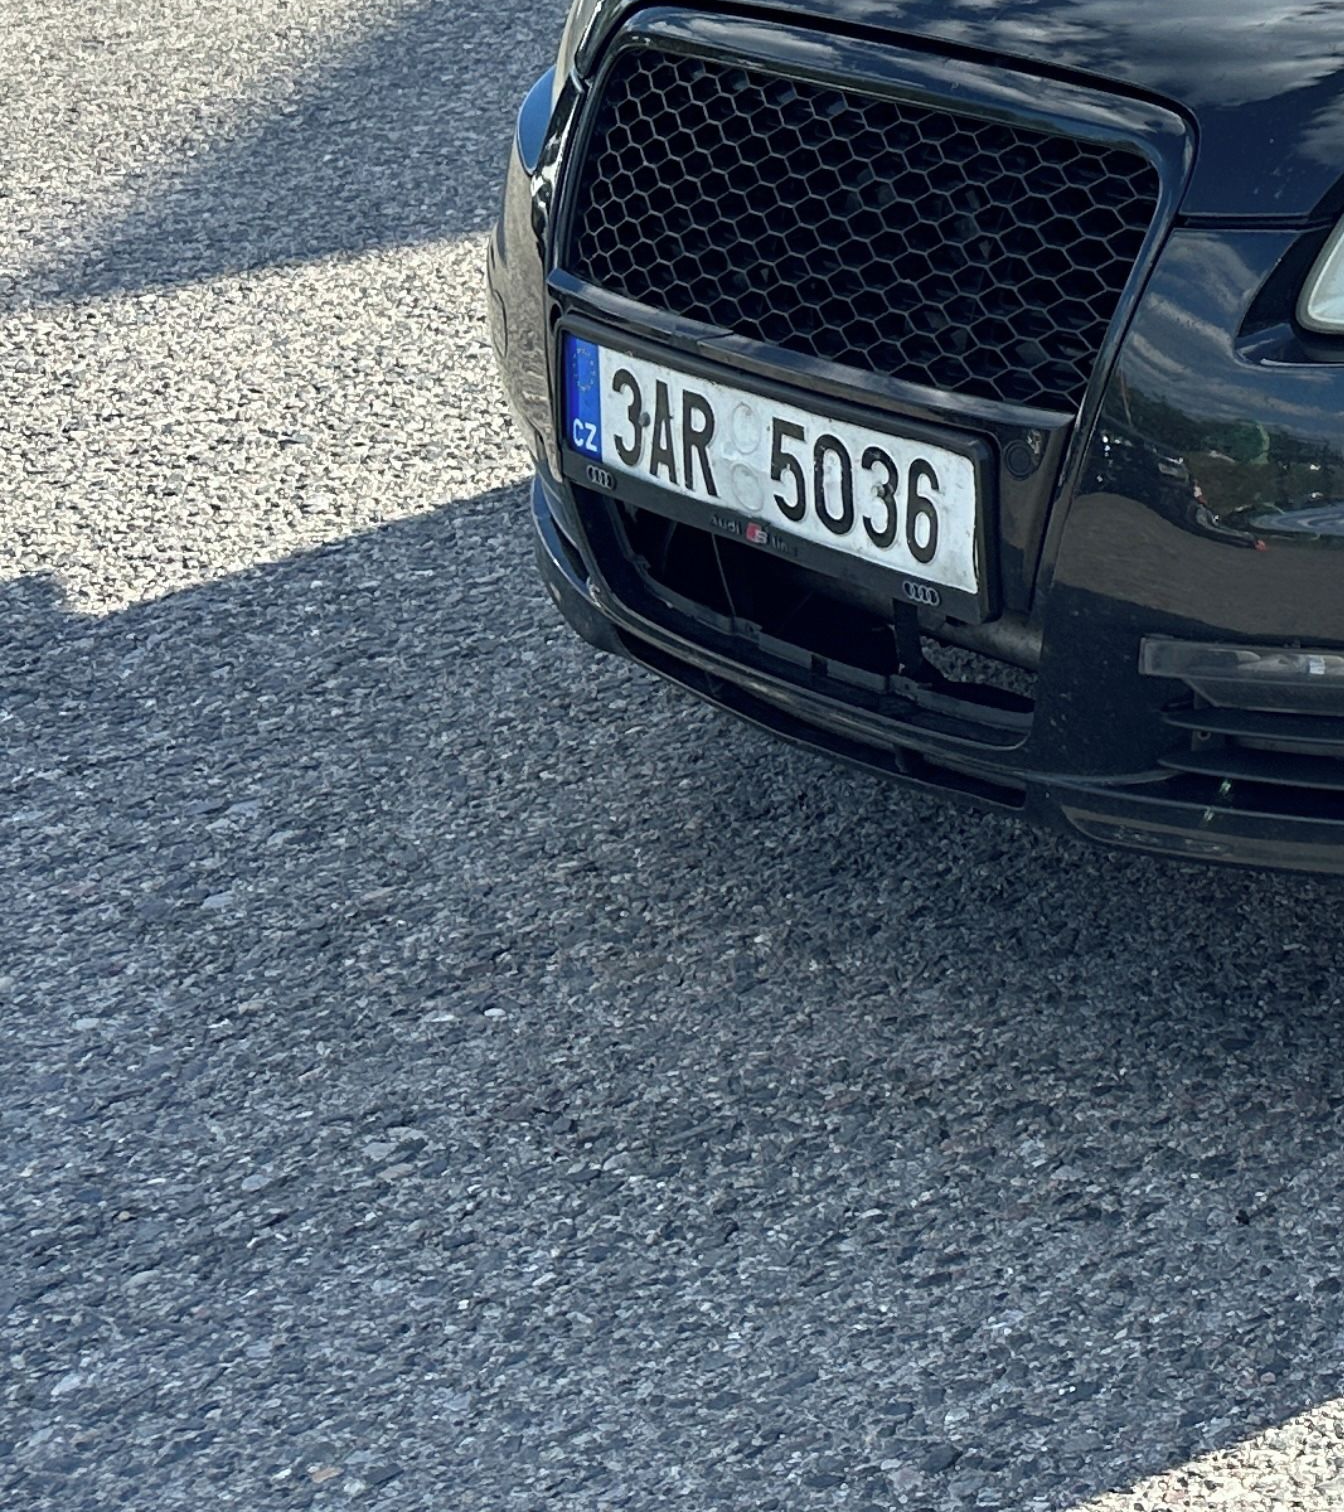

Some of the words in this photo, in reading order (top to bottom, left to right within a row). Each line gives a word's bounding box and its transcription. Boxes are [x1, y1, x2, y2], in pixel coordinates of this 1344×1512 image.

[572, 417, 598, 452] CZ
[611, 367, 719, 498] 3AR
[770, 415, 940, 565] 5036
